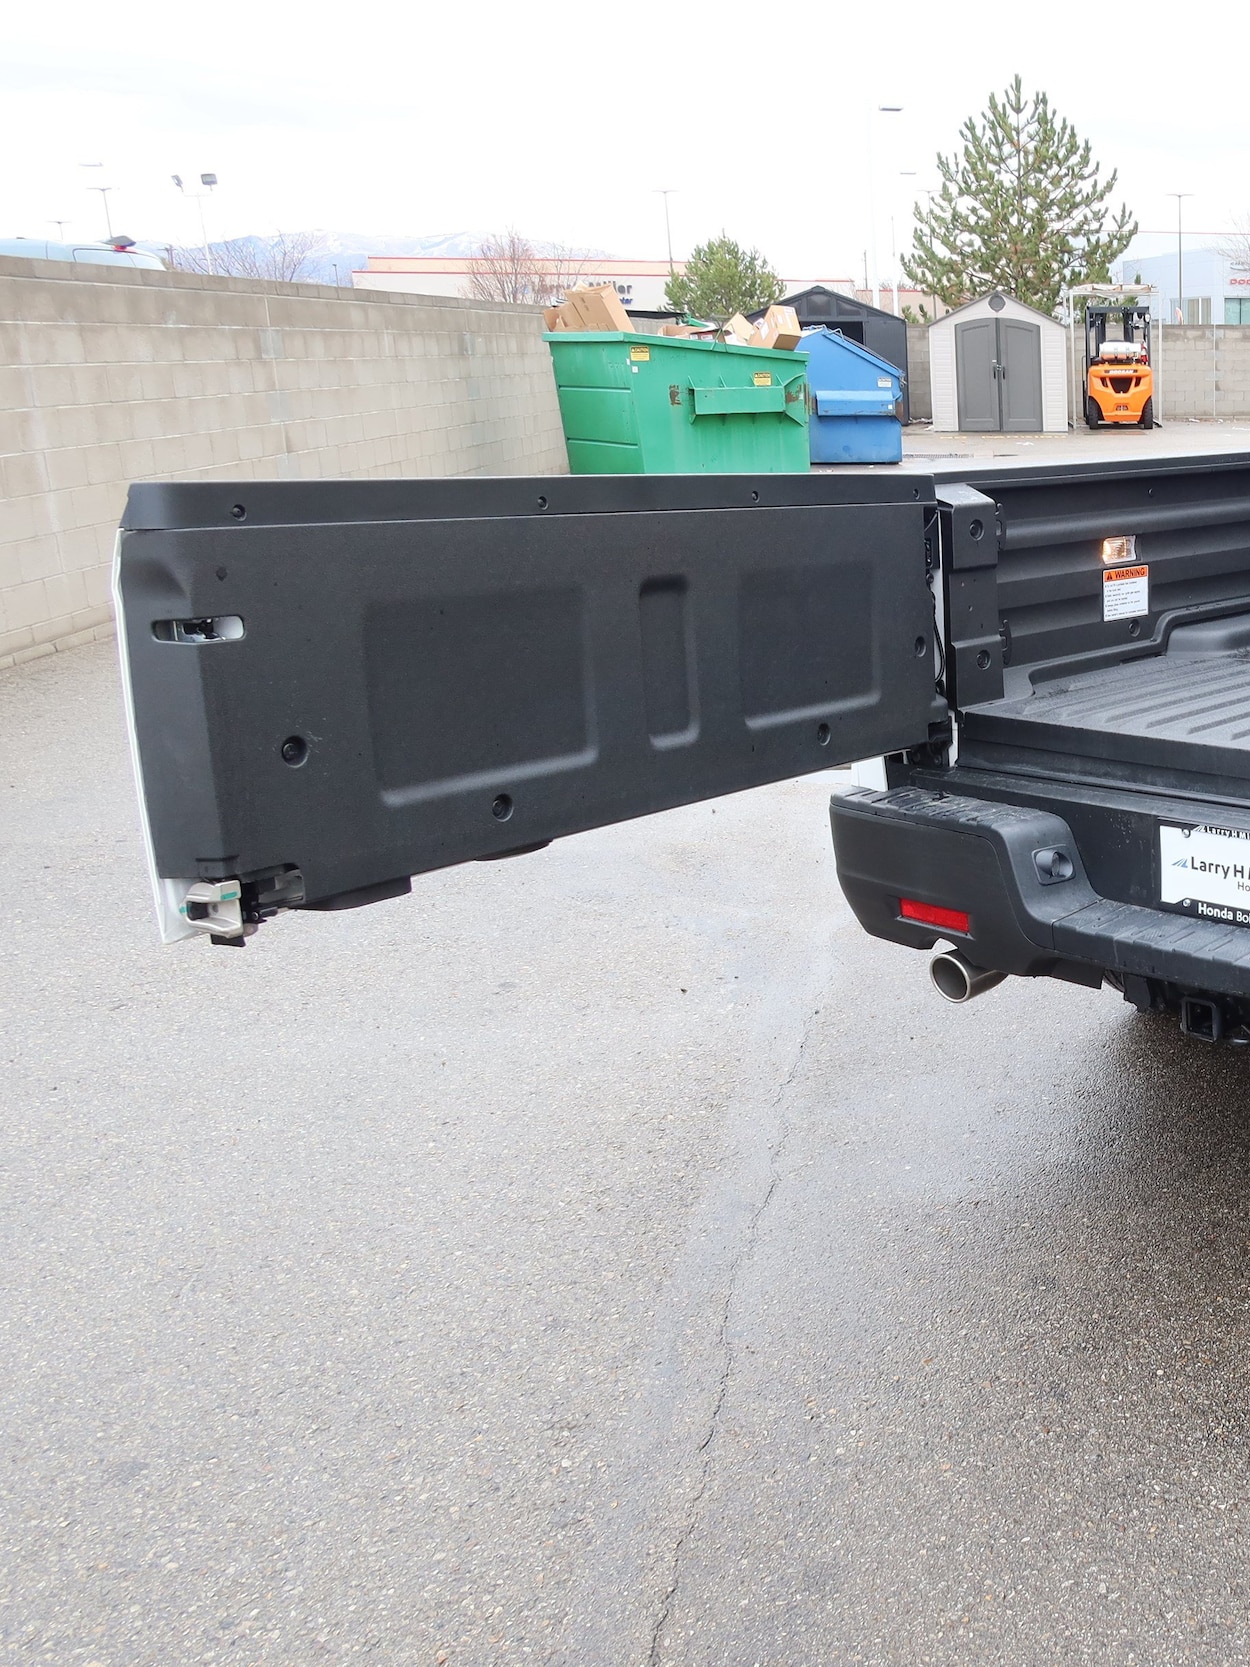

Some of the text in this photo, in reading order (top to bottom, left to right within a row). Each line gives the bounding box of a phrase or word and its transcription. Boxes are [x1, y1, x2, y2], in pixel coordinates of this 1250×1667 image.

[1115, 567, 1145, 579] WARNING
[1207, 825, 1231, 838] Larry
[1232, 829, 1238, 838] H
[1191, 856, 1230, 879] Larry
[1234, 864, 1244, 879] H
[1198, 902, 1234, 921] Honda
